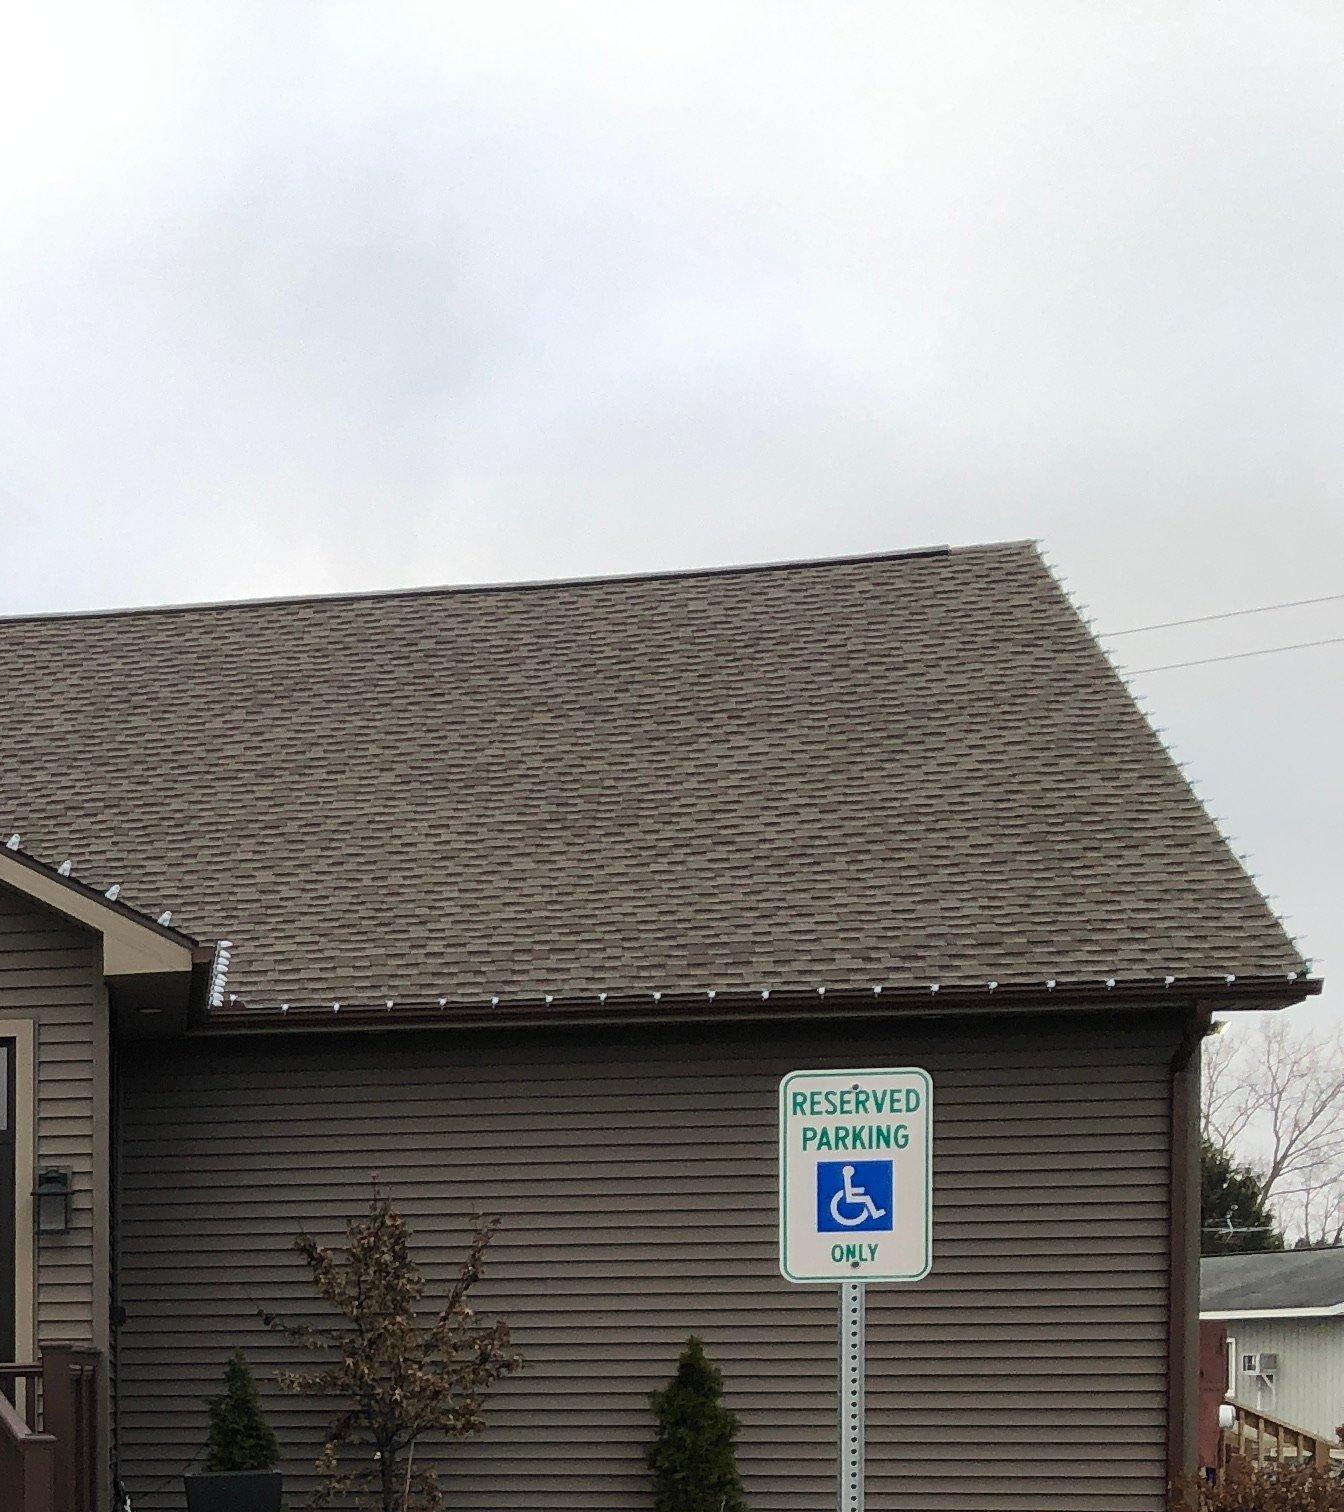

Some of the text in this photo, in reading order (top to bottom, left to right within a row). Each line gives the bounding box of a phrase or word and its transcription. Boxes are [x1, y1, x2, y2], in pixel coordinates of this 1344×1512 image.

[792, 1088, 921, 1115] RESERVED
[802, 1125, 909, 1151] PARKING
[831, 1243, 879, 1262] ONLY
